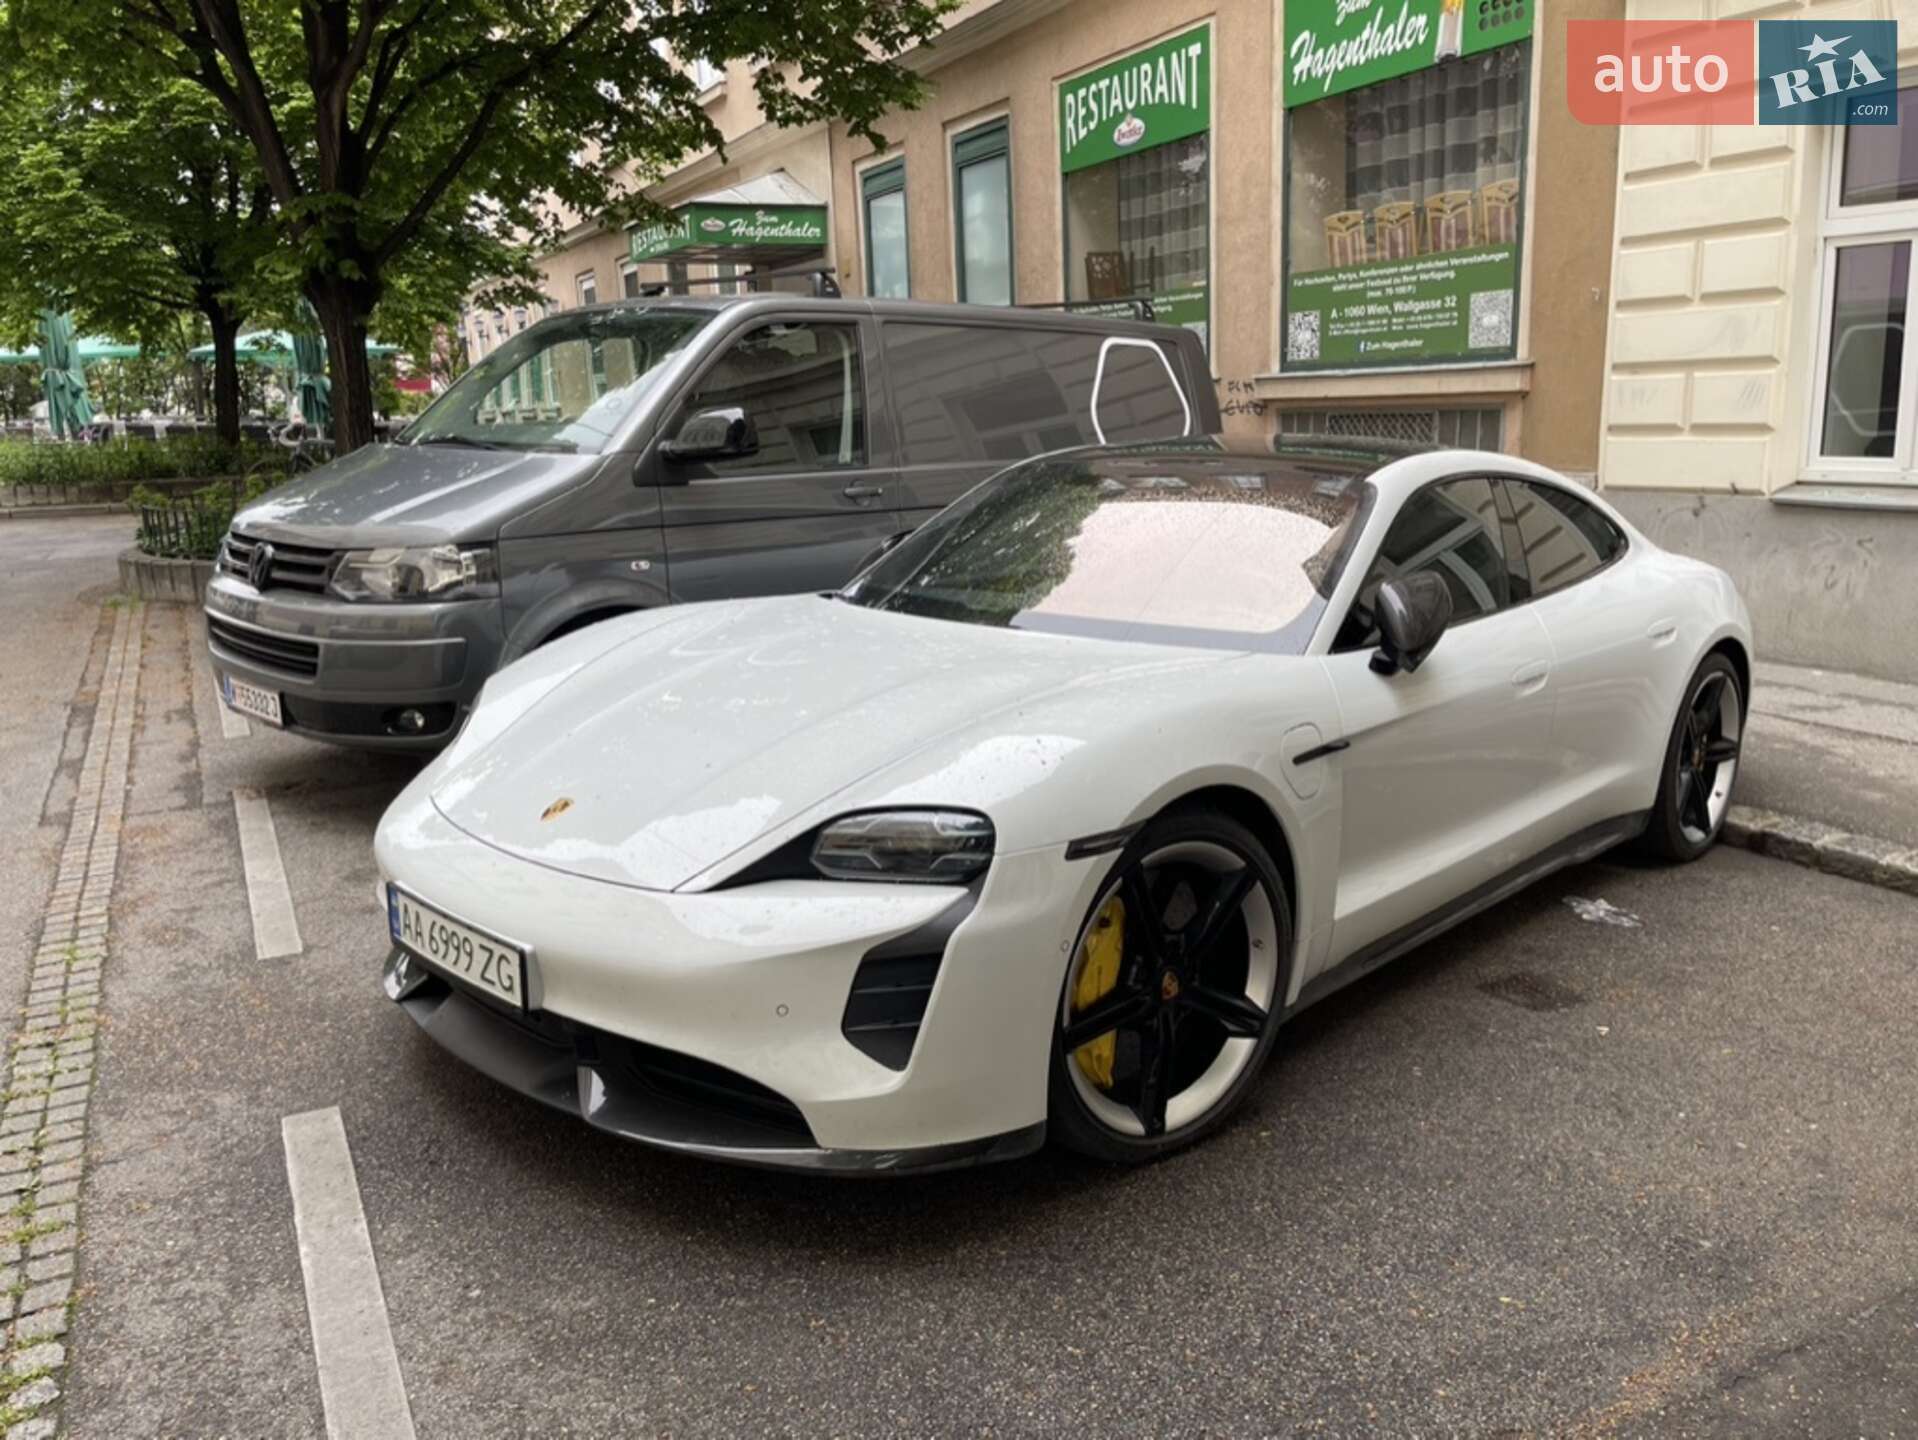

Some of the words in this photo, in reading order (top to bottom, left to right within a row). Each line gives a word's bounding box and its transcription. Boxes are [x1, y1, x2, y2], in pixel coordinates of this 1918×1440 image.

[1290, 1, 1428, 92] Hagenthaler
[1065, 42, 1202, 154] RESTAURANT
[728, 217, 822, 242] Hagenthaler
[755, 209, 778, 224] Zum
[1331, 307, 1338, 319] A
[1344, 304, 1366, 317] 1060
[1367, 302, 1392, 315] Wien,
[1393, 298, 1442, 313] Wallgasse
[1444, 294, 1457, 308] 32
[403, 903, 424, 948] AA
[429, 920, 473, 973] 6999
[479, 943, 514, 993] ZG
